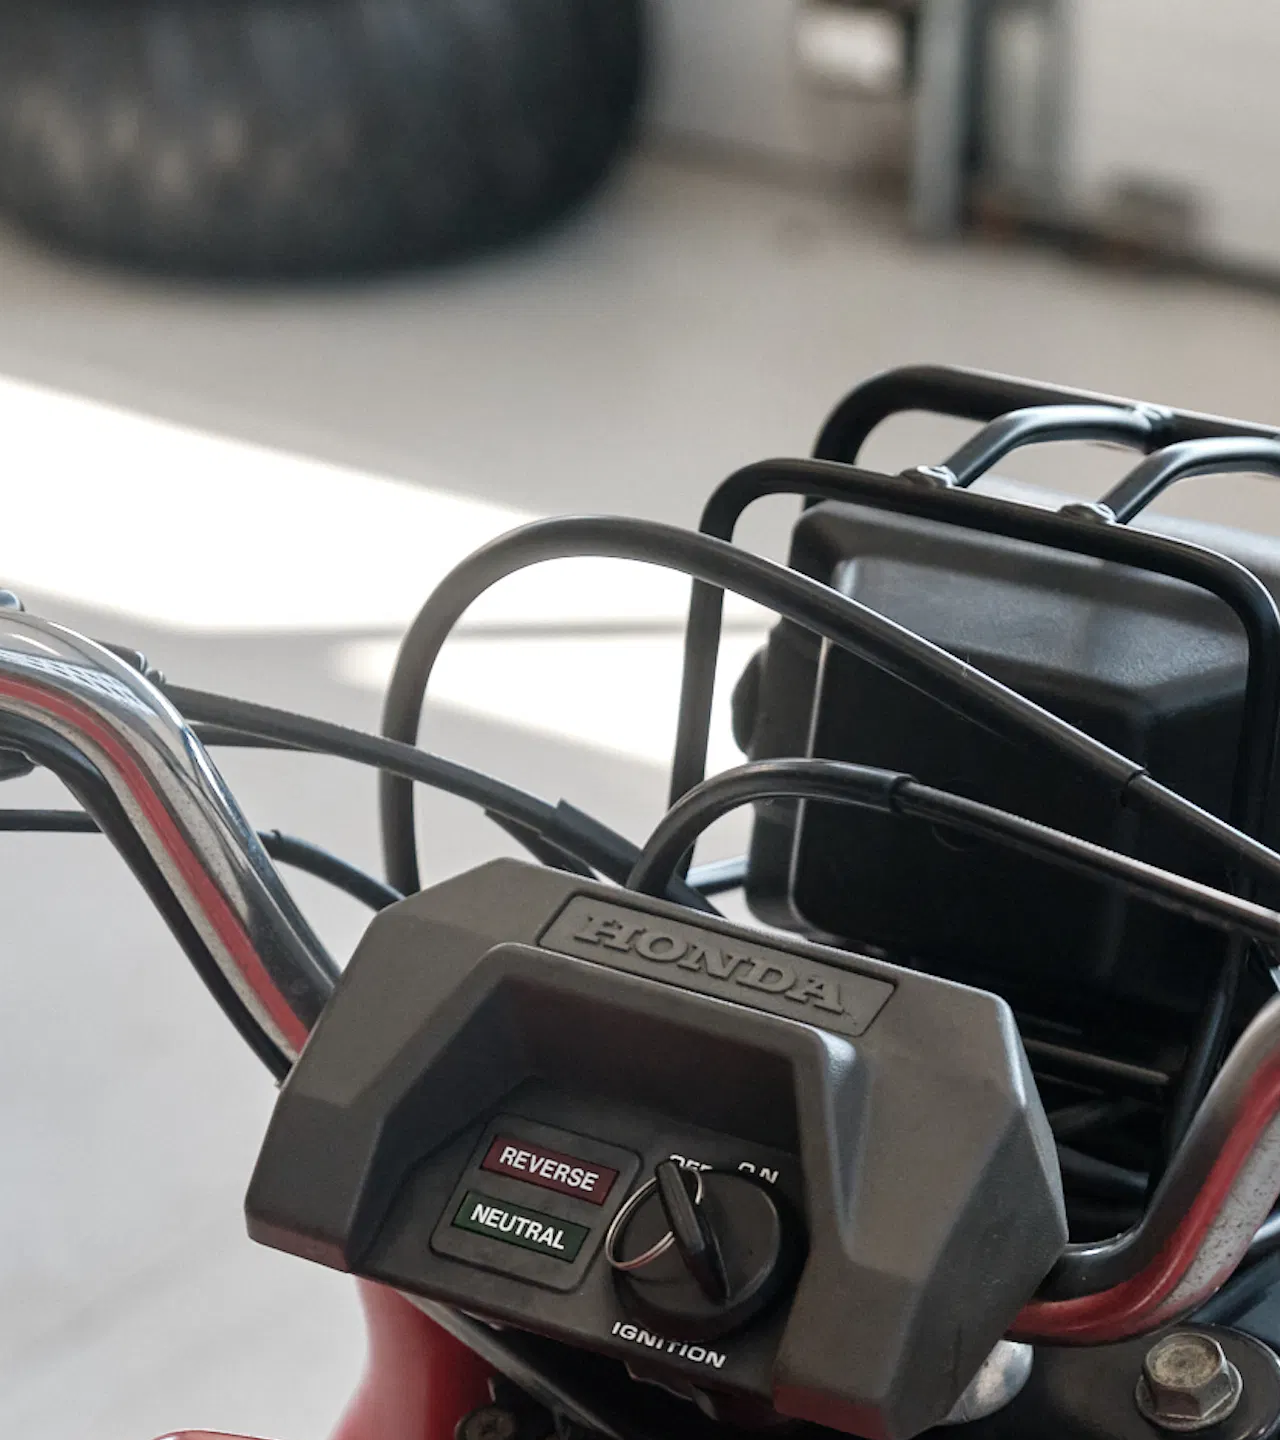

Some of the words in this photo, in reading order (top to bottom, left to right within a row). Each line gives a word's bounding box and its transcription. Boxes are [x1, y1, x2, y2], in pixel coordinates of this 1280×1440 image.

[573, 915, 846, 1015] HONDA
[498, 1145, 600, 1193] REVERSE
[469, 1202, 566, 1251] NEUTRAL
[610, 1320, 727, 1369] IGNITION
